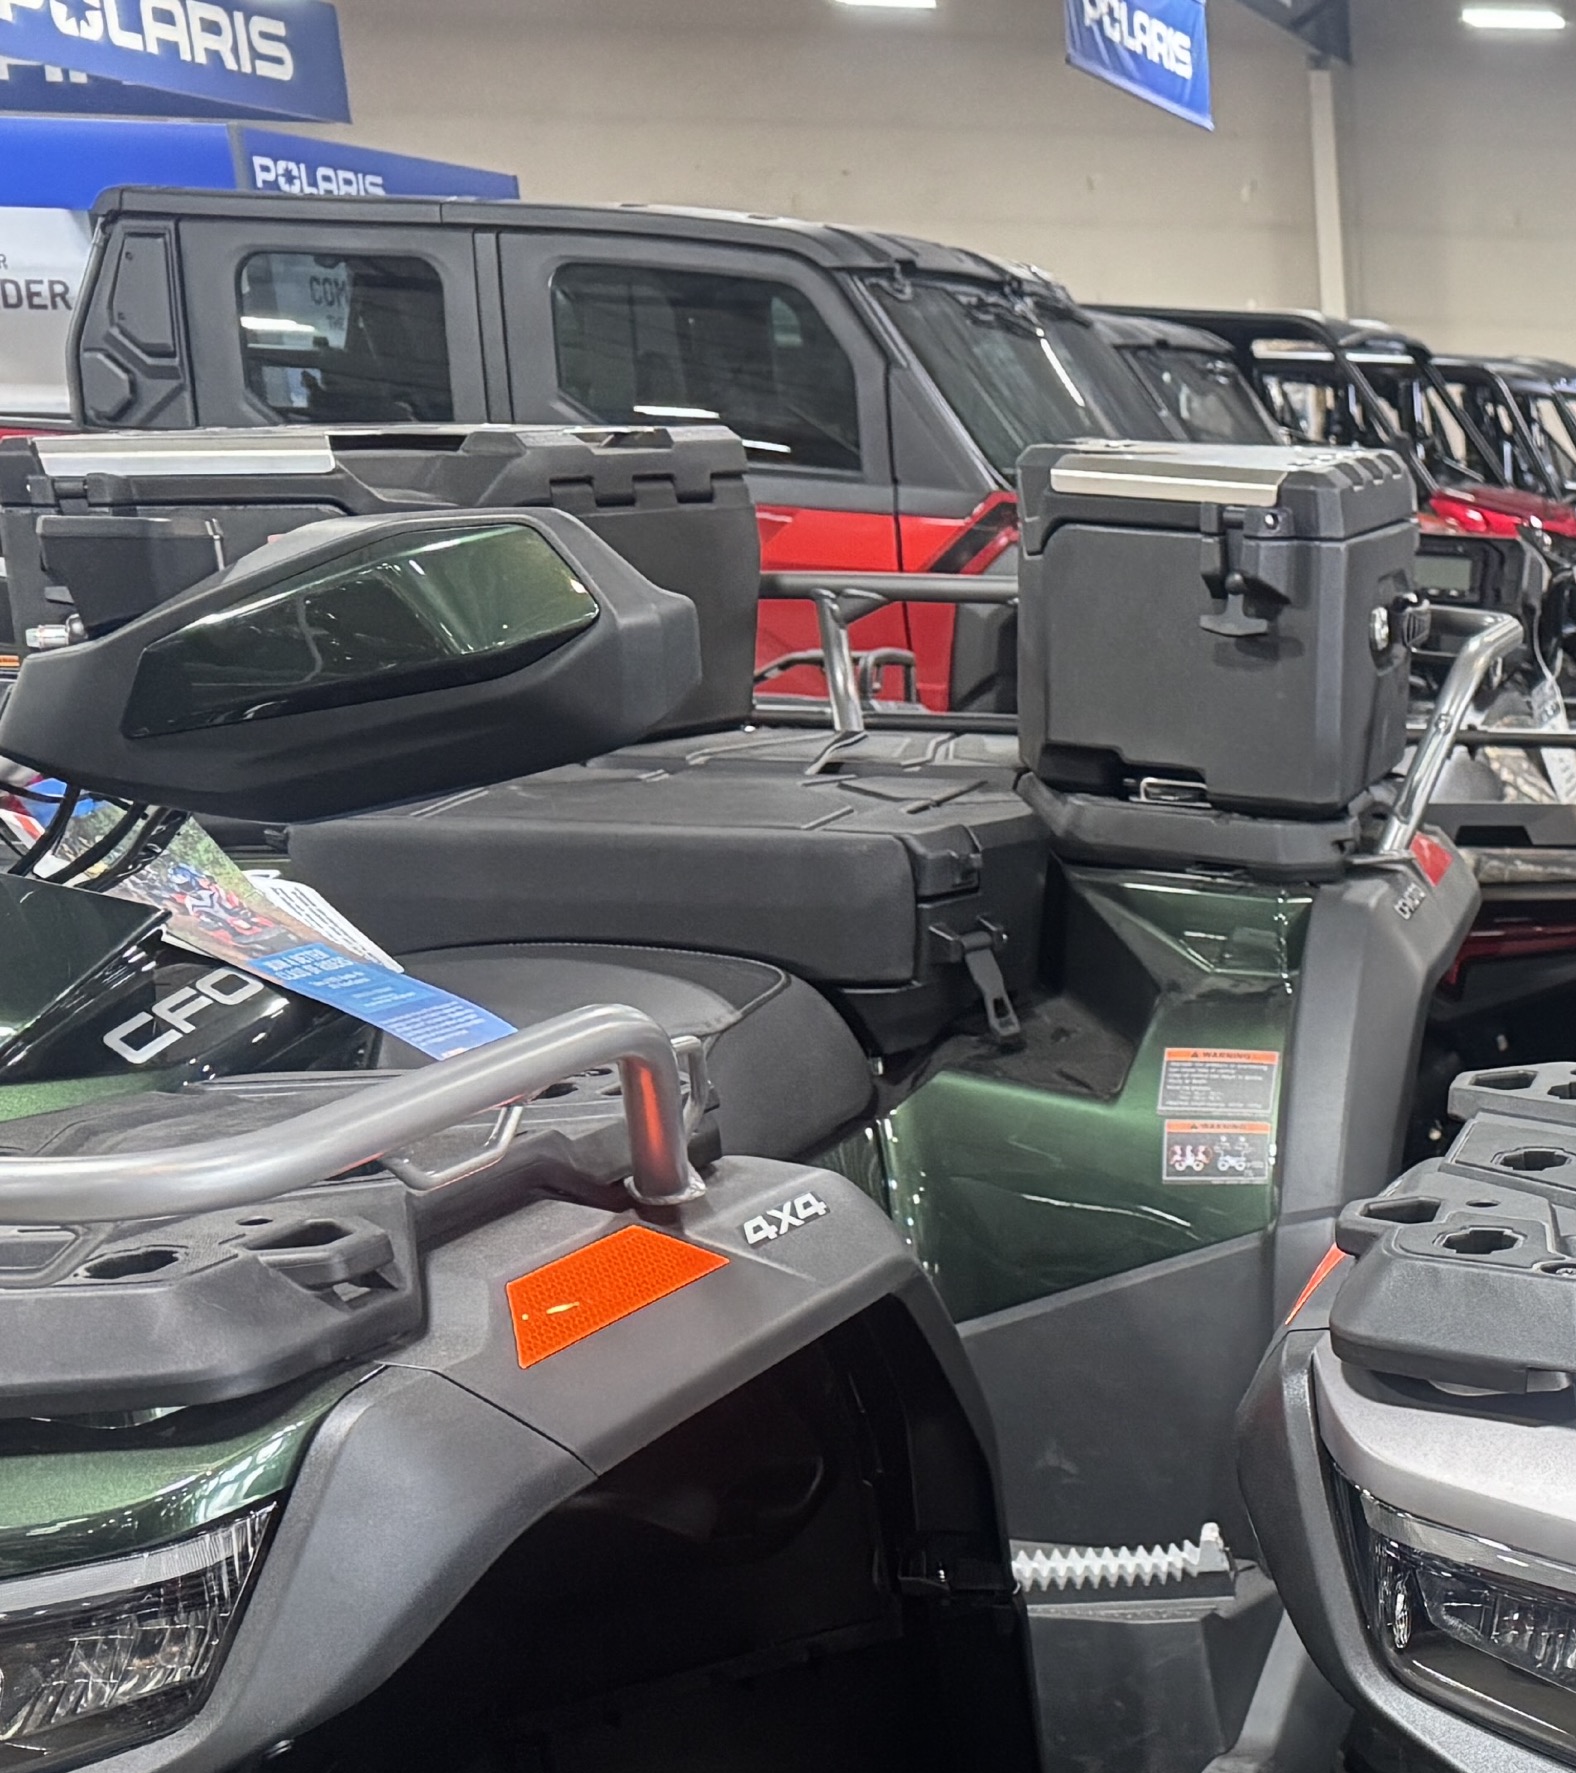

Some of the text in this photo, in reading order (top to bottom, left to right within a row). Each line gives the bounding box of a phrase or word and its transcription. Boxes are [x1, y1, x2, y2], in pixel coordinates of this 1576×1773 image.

[252, 155, 386, 196] POLARIS
[1202, 1051, 1252, 1060] WARNING
[743, 1192, 828, 1245] 4X4
